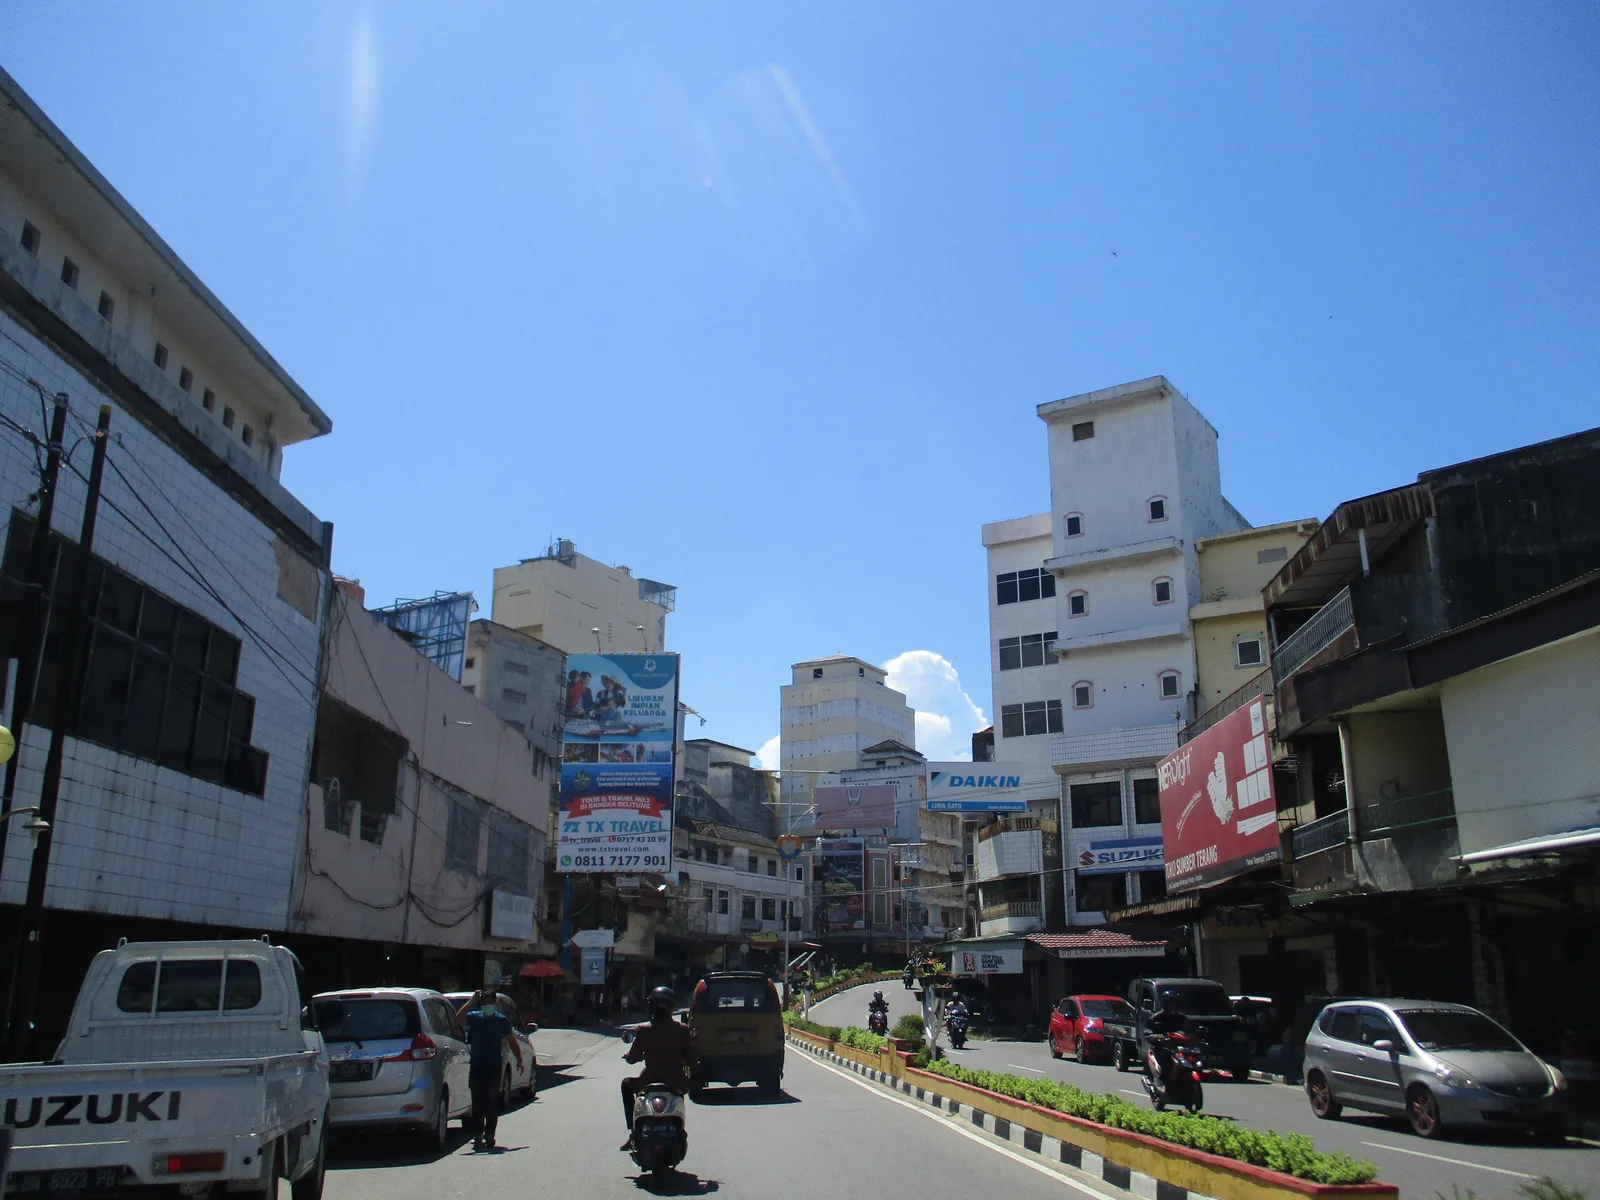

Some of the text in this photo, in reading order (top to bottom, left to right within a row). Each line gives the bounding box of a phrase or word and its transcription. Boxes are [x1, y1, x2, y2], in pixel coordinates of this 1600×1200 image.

[623, 709, 666, 717] KELUARGA
[949, 775, 1020, 787] DAIKIN
[581, 796, 600, 804] TOUR
[588, 801, 617, 809] BANGKA
[617, 801, 651, 809] BELITUNG
[586, 820, 605, 833] TX
[609, 820, 664, 833] TRAVEL
[657, 835, 667, 843] 99
[574, 855, 667, 866] 0811 7177 901
[1176, 852, 1197, 875] SUMBER
[1196, 844, 1218, 869] TERANG
